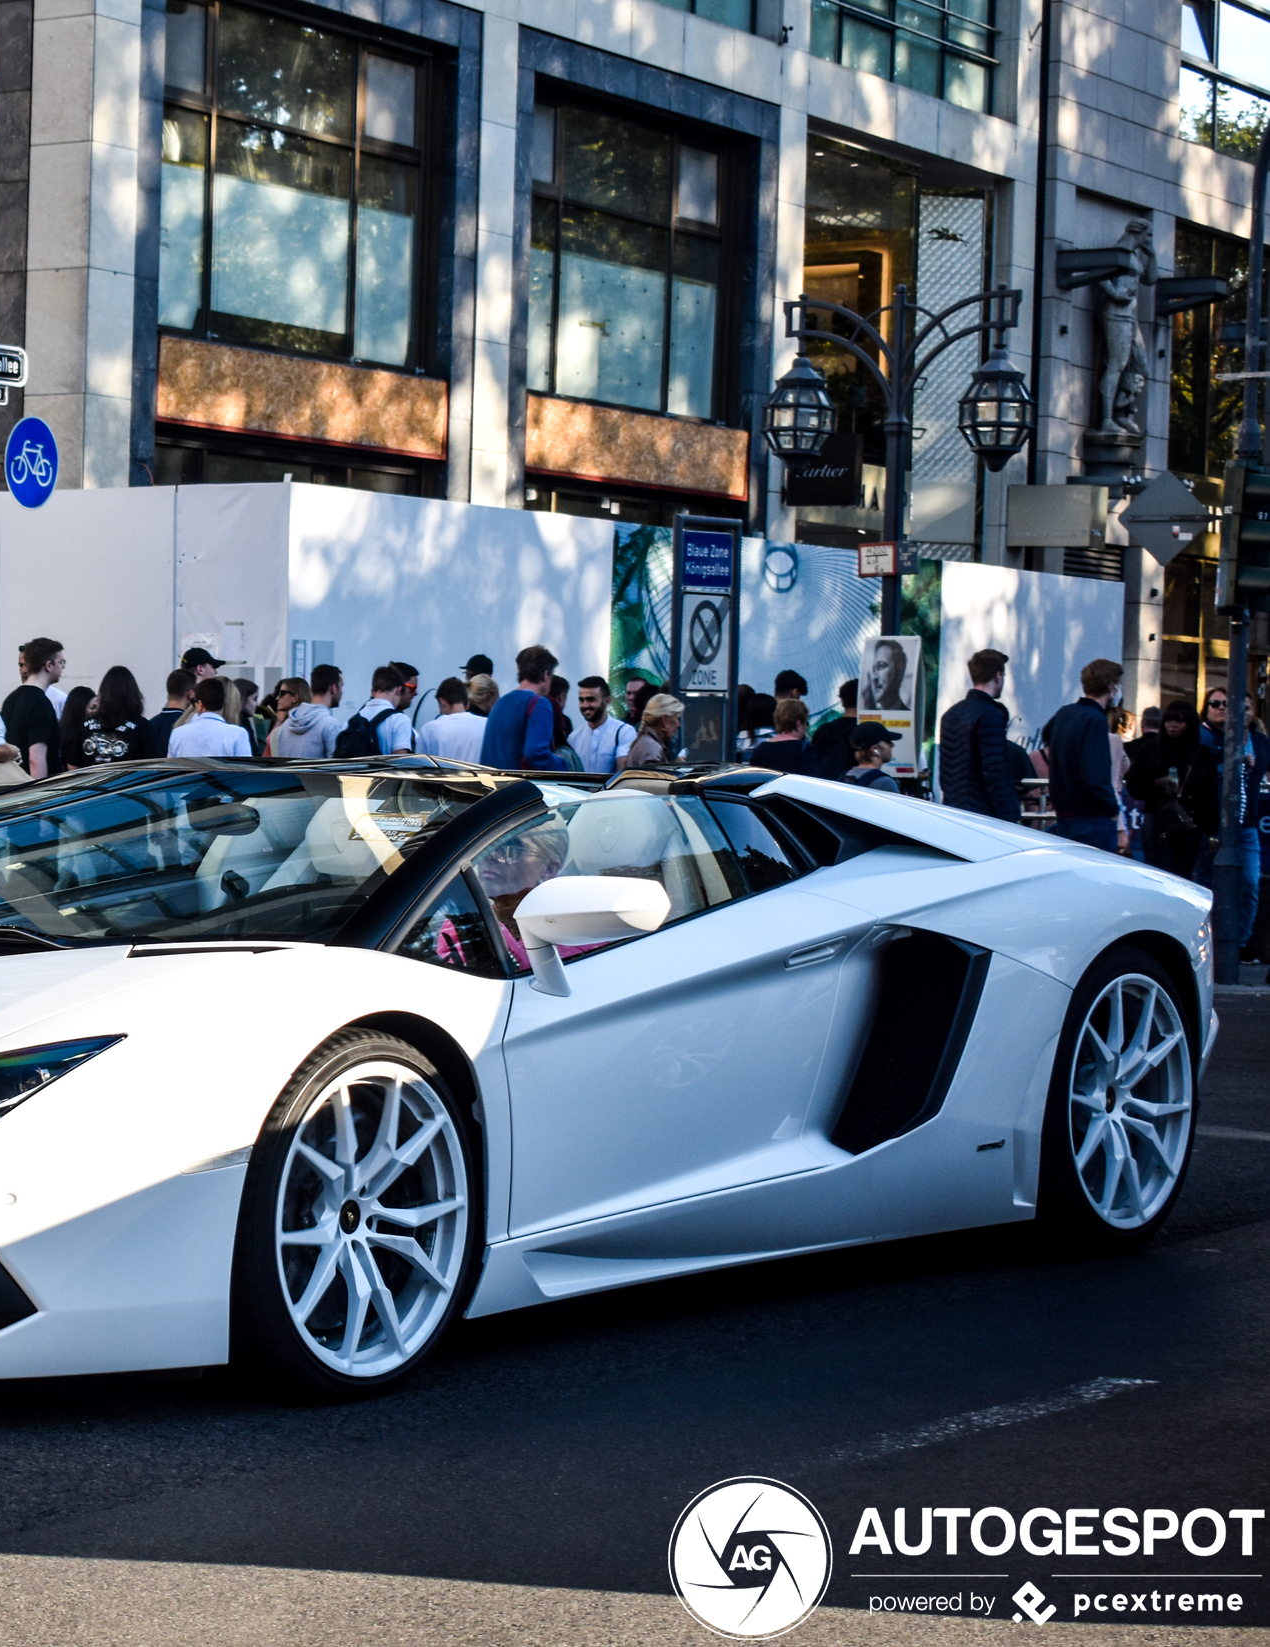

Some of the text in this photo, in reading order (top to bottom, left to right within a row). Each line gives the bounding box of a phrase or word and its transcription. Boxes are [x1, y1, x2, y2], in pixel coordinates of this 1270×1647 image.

[686, 543, 729, 558] Blaue Zone
[685, 562, 729, 578] Königsallee
[691, 670, 717, 685] ZONE
